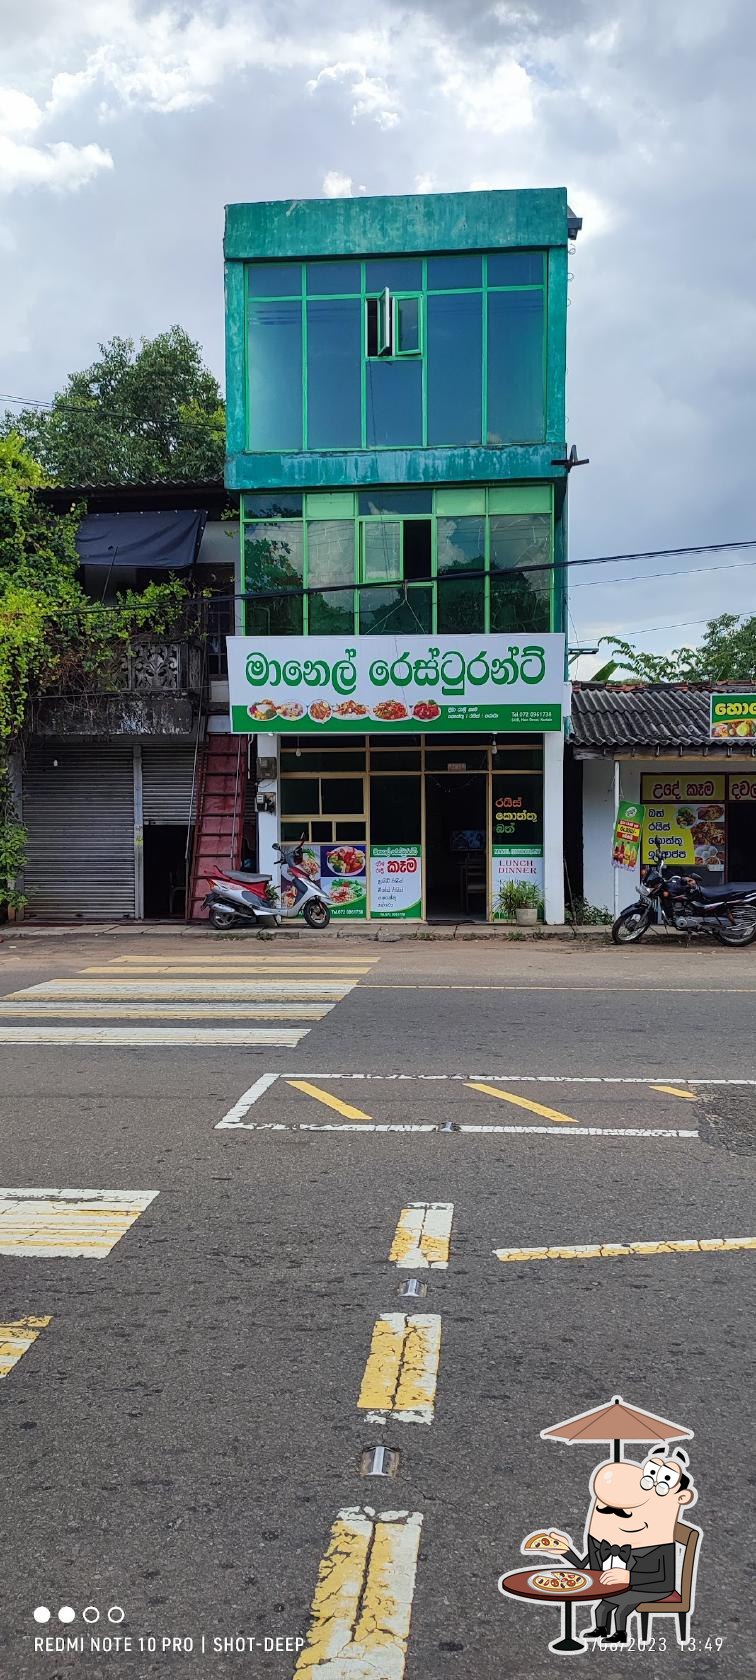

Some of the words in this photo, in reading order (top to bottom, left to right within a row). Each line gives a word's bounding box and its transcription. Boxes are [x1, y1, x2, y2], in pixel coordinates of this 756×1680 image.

[245, 648, 357, 696] මානෙල්
[368, 646, 546, 696] රෙස්ටුරන්ට්
[653, 781, 681, 800] උදේ
[686, 781, 714, 796] කෑම
[495, 797, 522, 808] රයිස්
[495, 809, 538, 823] කොත්තු
[495, 823, 515, 834] බත්
[387, 858, 418, 873] කෑම
